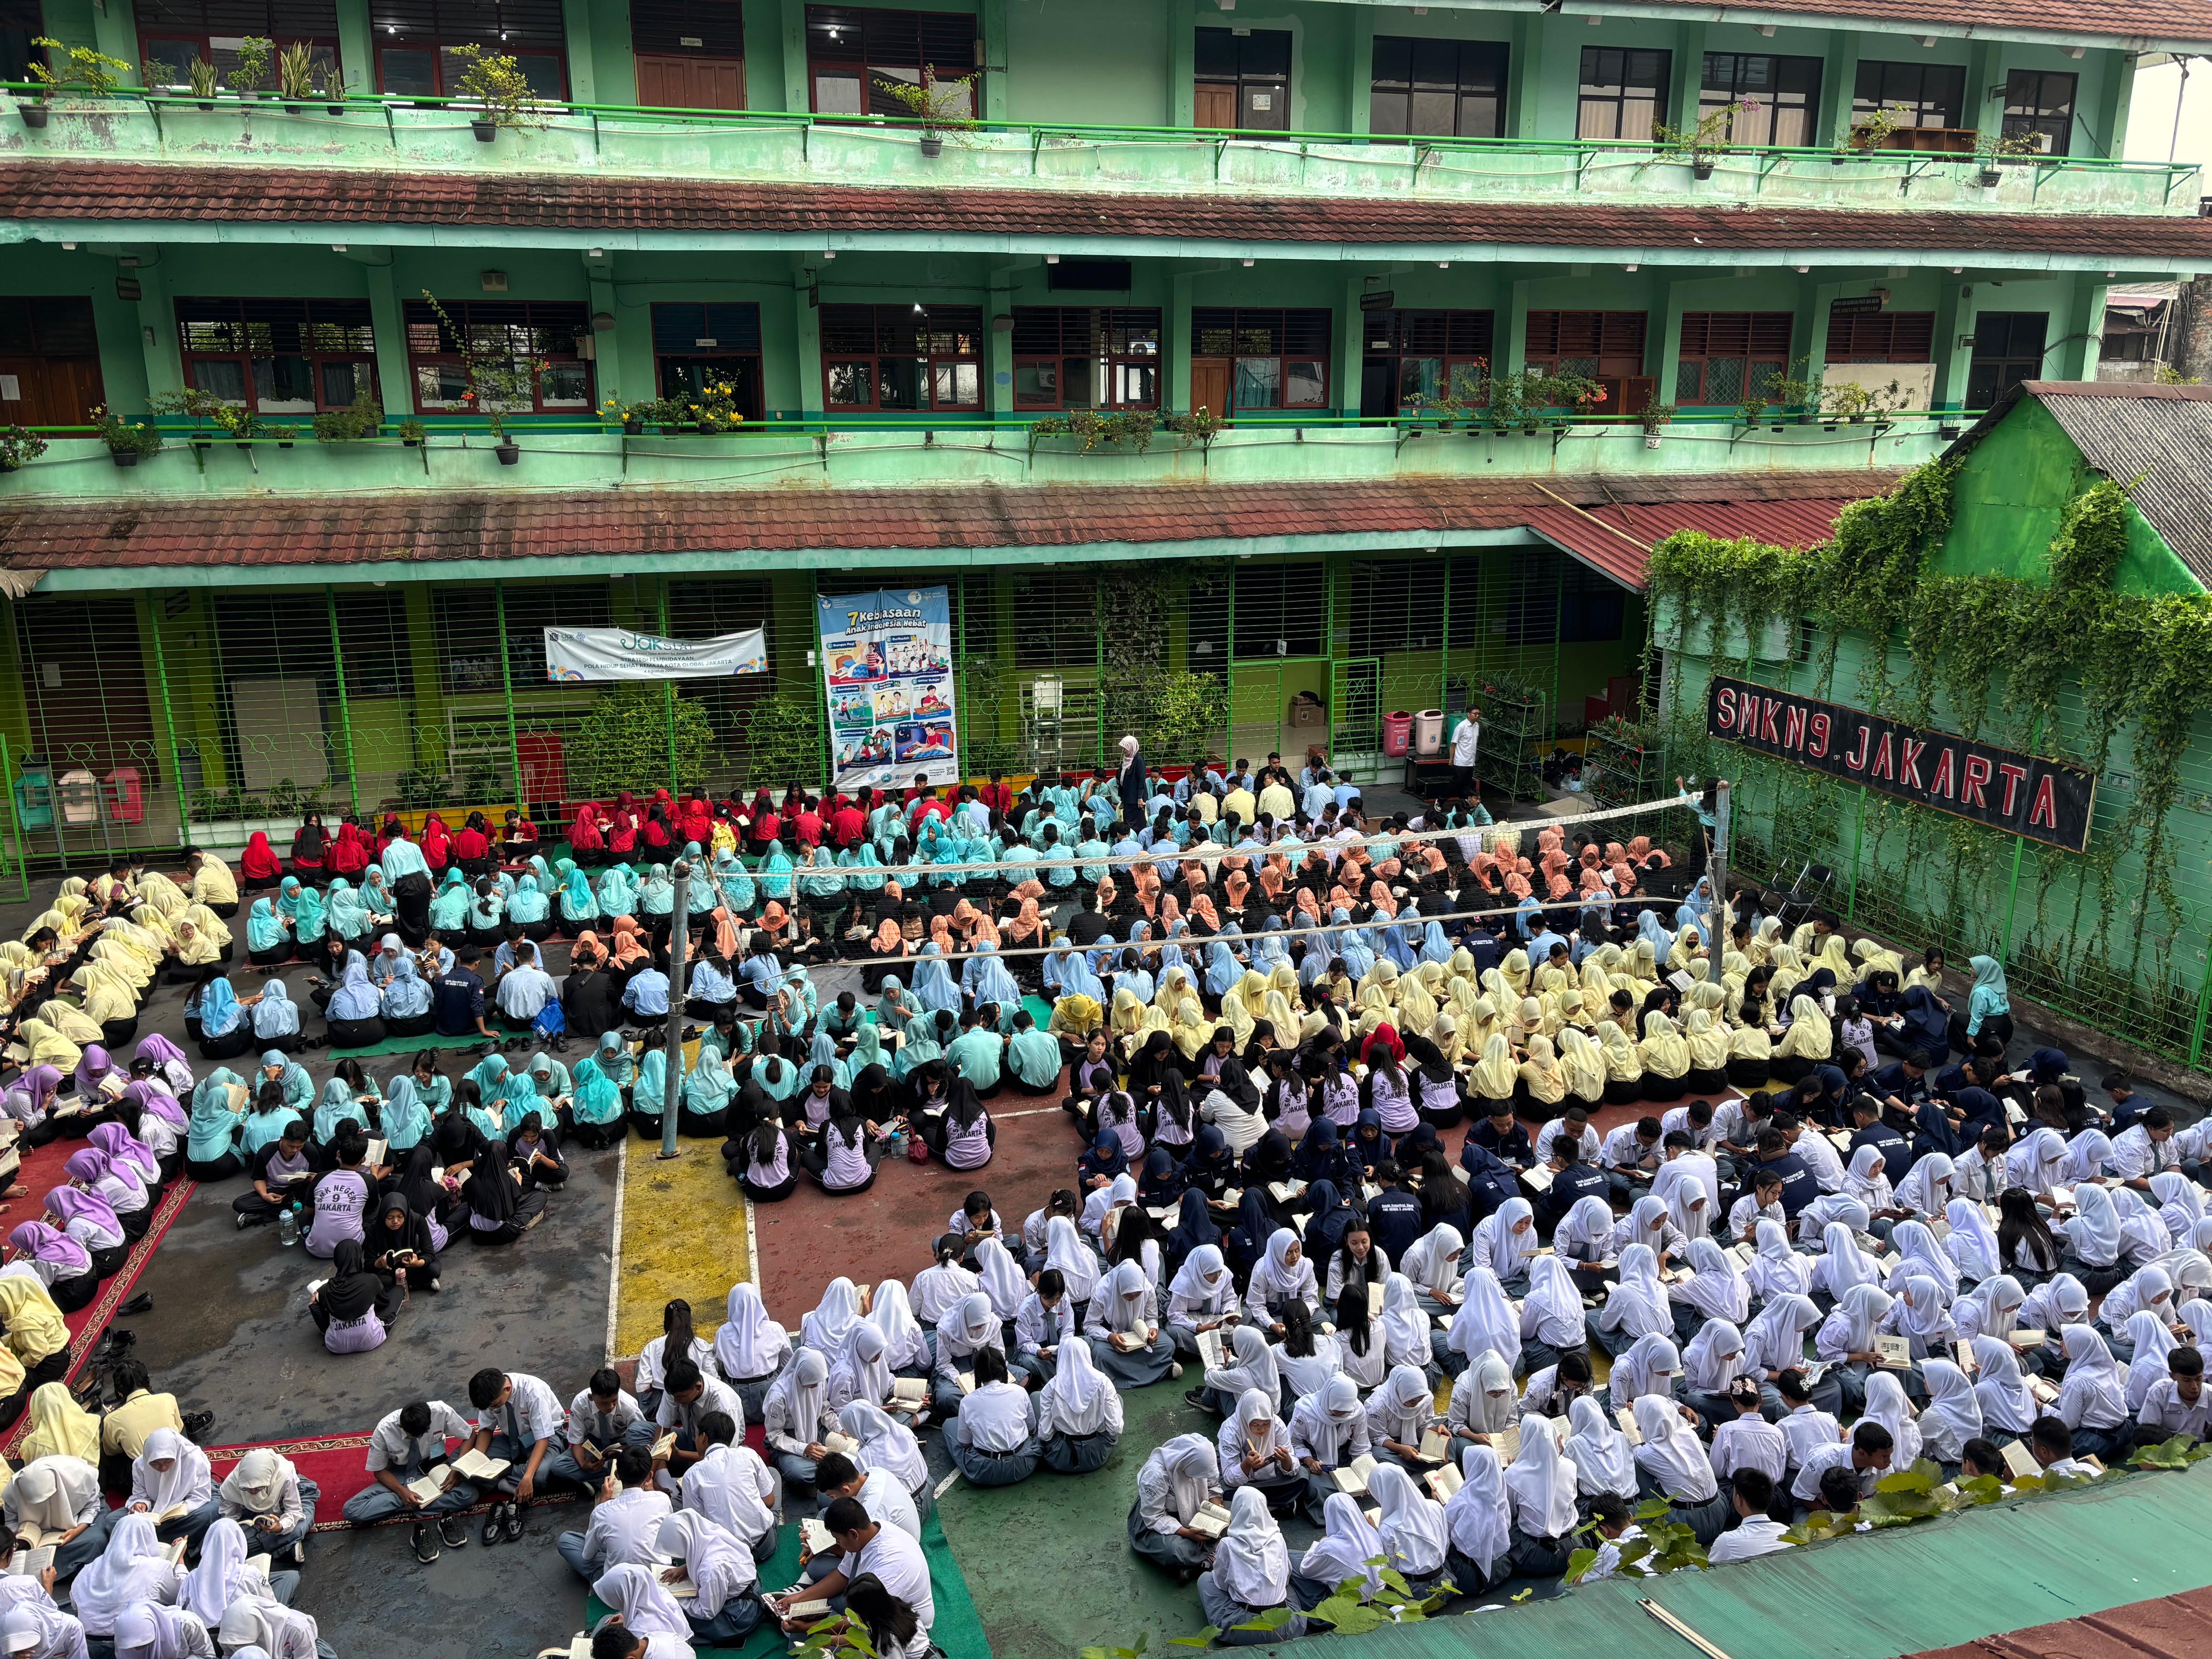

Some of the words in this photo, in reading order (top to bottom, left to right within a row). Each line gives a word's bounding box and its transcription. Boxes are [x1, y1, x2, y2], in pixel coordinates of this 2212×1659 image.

[848, 610, 859, 626] 7
[859, 608, 921, 624] Kebiasaan
[845, 625, 867, 635] Anak
[903, 619, 927, 629] Hebat
[1846, 726, 2057, 829] JAKARTA
[1855, 1023, 1873, 1035] NEGER
[1339, 1083, 1358, 1098] EGERI
[1380, 1080, 1388, 1096] SMK
[1430, 1082, 1454, 1092] JAKARTA
[1285, 1092, 1293, 1108] SMK
[1384, 1091, 1408, 1101] JAKARTA
[1288, 1103, 1306, 1113] JAKART
[1333, 1099, 1356, 1109] JAKARTA
[1109, 1117, 1134, 1128] JAKARTA
[829, 1127, 838, 1142] SMK
[956, 1129, 982, 1139] JAKARTA
[317, 1187, 331, 1203] SMK
[333, 1185, 356, 1204] NEGERI
[332, 1194, 340, 1202] 9
[318, 1203, 351, 1212] JAKARTA
[334, 1317, 366, 1331] JAKARTA
